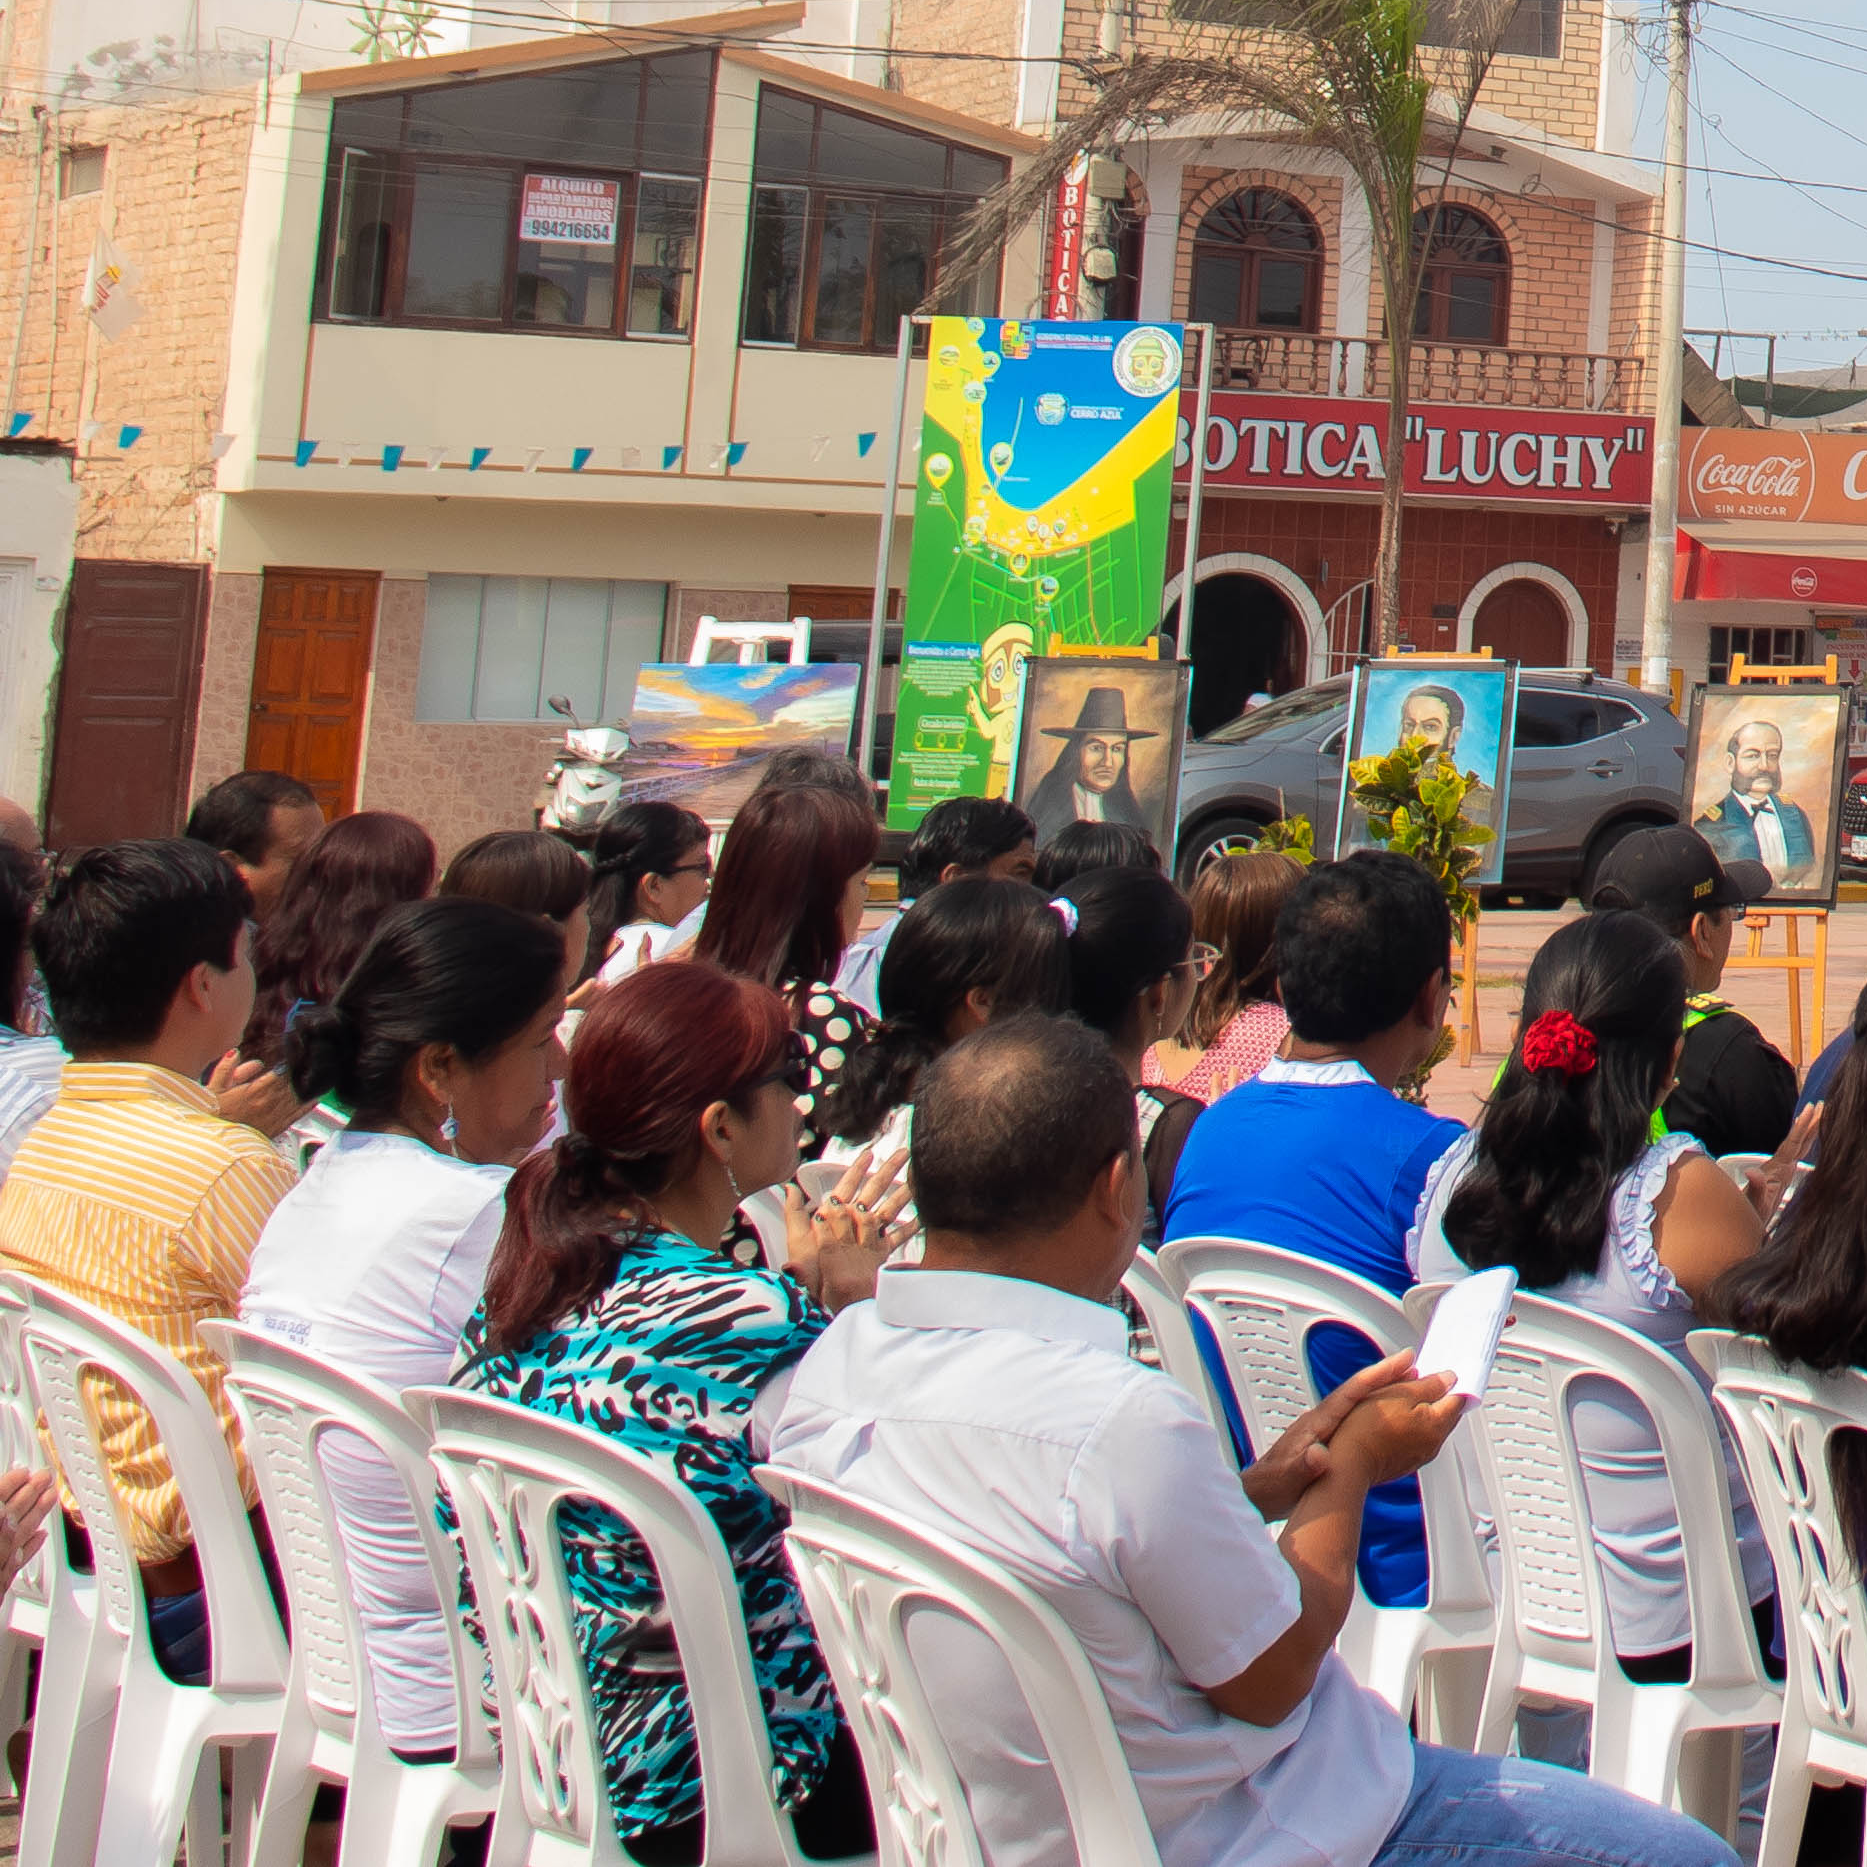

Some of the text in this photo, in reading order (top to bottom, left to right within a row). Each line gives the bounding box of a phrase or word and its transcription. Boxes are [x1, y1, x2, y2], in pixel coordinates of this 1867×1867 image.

[540, 178, 605, 195] ALQUILO
[527, 191, 615, 211] DEPARTAMENTOS
[531, 219, 610, 240] 994216654
[1404, 416, 1646, 491] "LUCHY"
[1696, 453, 1805, 497] Coca-Cola
[1714, 503, 1788, 517] SIN AZÚCAR
